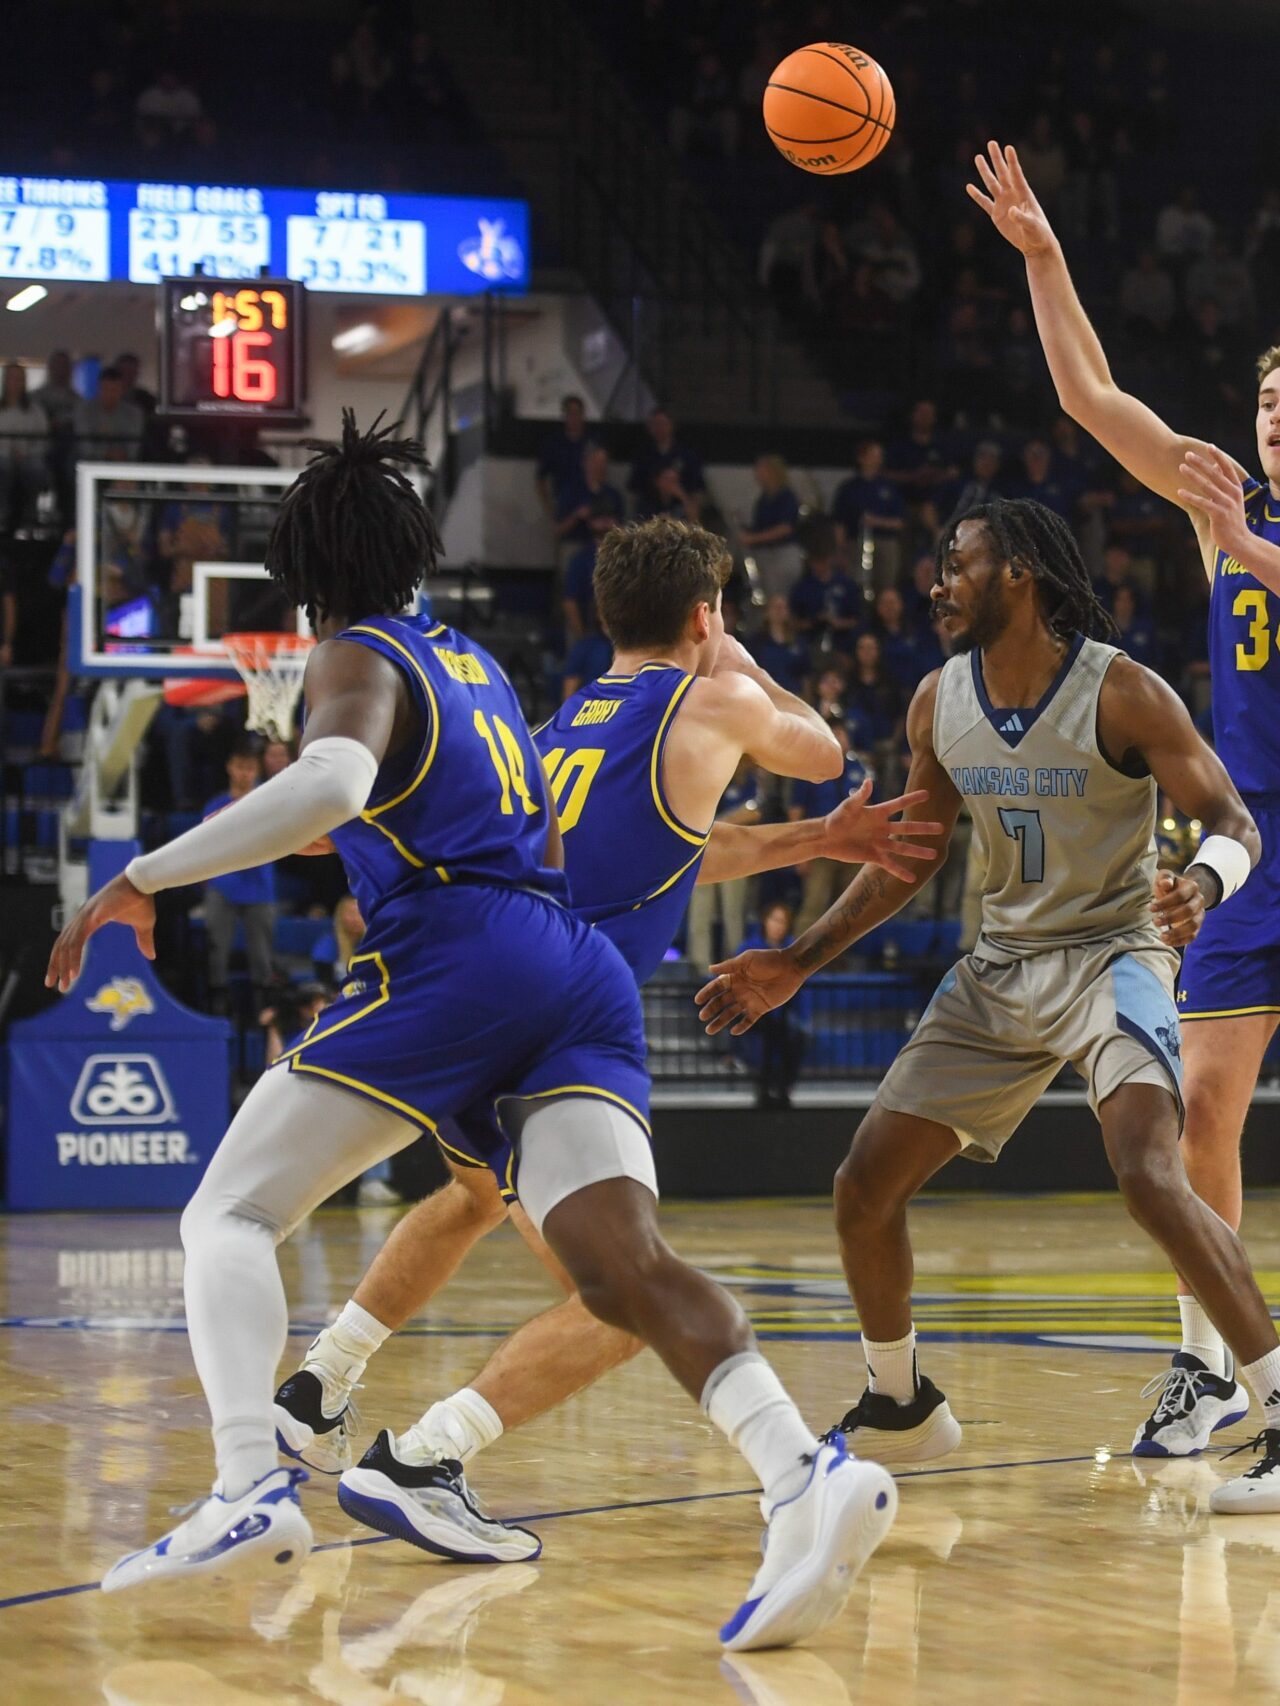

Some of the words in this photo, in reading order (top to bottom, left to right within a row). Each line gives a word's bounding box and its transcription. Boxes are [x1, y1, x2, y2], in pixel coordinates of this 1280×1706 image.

[213, 331, 276, 402] 16
[570, 699, 627, 727] GARRY
[473, 709, 541, 816] 14
[950, 767, 1029, 797] KANSAS
[1034, 768, 1088, 797] CITY
[997, 807, 1045, 883] 7
[57, 1131, 190, 1166] PIONEER
